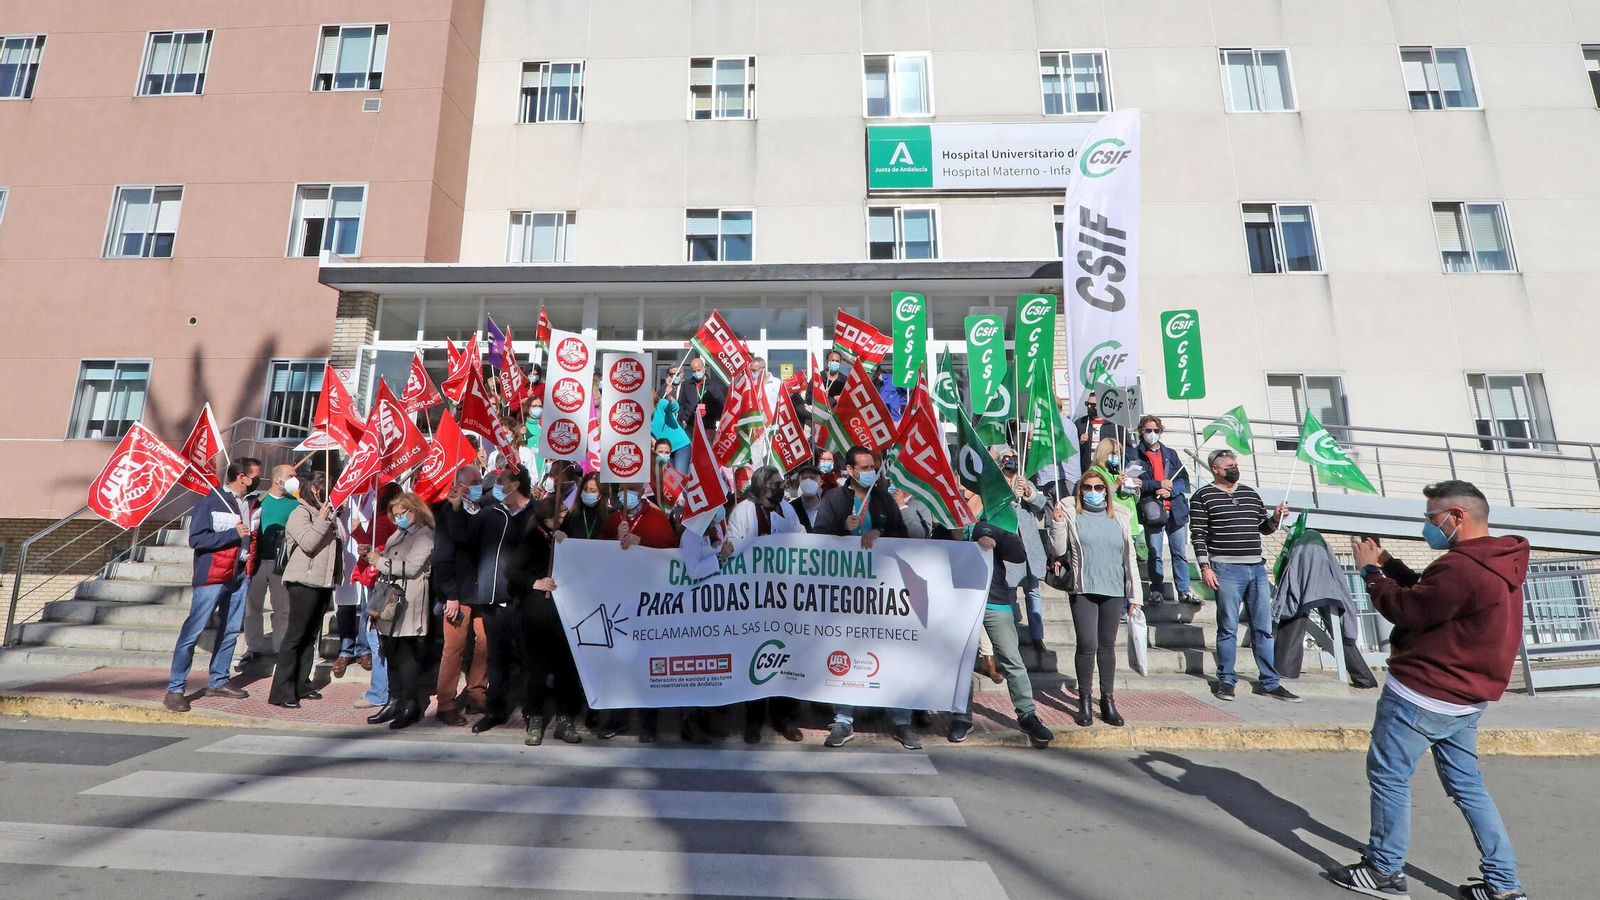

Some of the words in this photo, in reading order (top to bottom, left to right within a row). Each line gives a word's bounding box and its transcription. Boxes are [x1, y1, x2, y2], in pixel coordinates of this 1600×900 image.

[942, 149, 988, 161] Hospital
[991, 149, 1064, 159] Universitario
[1089, 150, 1132, 165] CSIF
[943, 167, 990, 178] Hospital
[993, 166, 1040, 176] Materno
[1076, 205, 1127, 312] CSIF
[901, 303, 921, 313] CSIF
[1026, 305, 1051, 316] CSIF
[976, 326, 999, 337] CSIF
[1171, 320, 1195, 331] CSIF
[563, 339, 583, 350] UGT
[705, 316, 746, 370] CCOO
[616, 361, 638, 372] UGT
[718, 351, 736, 376] Cádiz
[560, 380, 580, 391] UGT
[616, 402, 637, 414] UGT
[1103, 396, 1123, 411] CSI-F
[463, 417, 492, 436] ASTURIAS
[555, 421, 575, 433] UGT
[849, 417, 873, 451] Cádiz
[614, 444, 636, 456] UGT
[377, 445, 421, 478] www.ugt.es
[101, 454, 143, 502] UGT
[669, 551, 748, 585] CARA
[752, 546, 877, 580] PROFESIONAL
[637, 591, 684, 617] PARA
[691, 581, 750, 613] TODAS
[755, 580, 787, 610] LAS
[793, 582, 910, 616] CATEGORÍAS
[633, 625, 720, 641] RECLAMAMOS
[723, 624, 739, 636] AL
[742, 621, 761, 635] SAS
[764, 620, 780, 632] LO
[784, 621, 810, 636] QUE
[815, 625, 842, 637] NOS
[846, 626, 918, 641] PERTENECE
[756, 653, 791, 670] CSIF
[830, 654, 848, 663] UGT
[673, 659, 718, 672] CCOO
